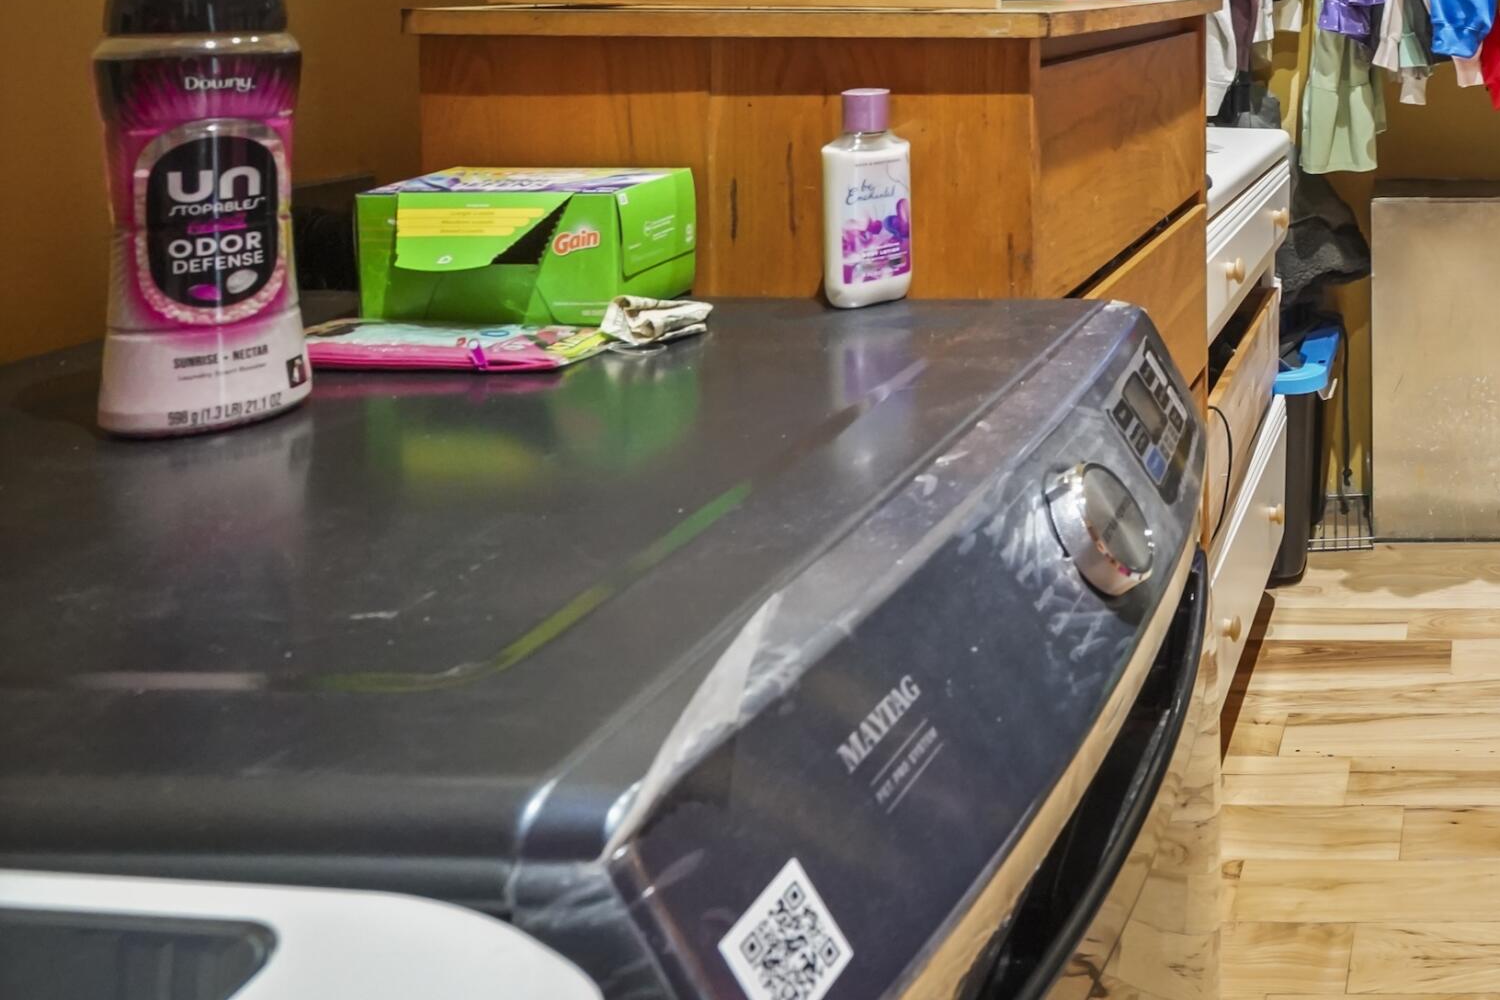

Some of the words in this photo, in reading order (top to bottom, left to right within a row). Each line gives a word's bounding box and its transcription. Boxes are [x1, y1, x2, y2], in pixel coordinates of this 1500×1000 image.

[184, 76, 252, 92] Downy
[168, 231, 262, 258] ODOR
[553, 231, 600, 256] Gain
[172, 250, 264, 275] DEFENSE
[173, 353, 218, 370] SUNRISE
[232, 344, 268, 361] NECTAR
[836, 674, 921, 775] MAYTAG
